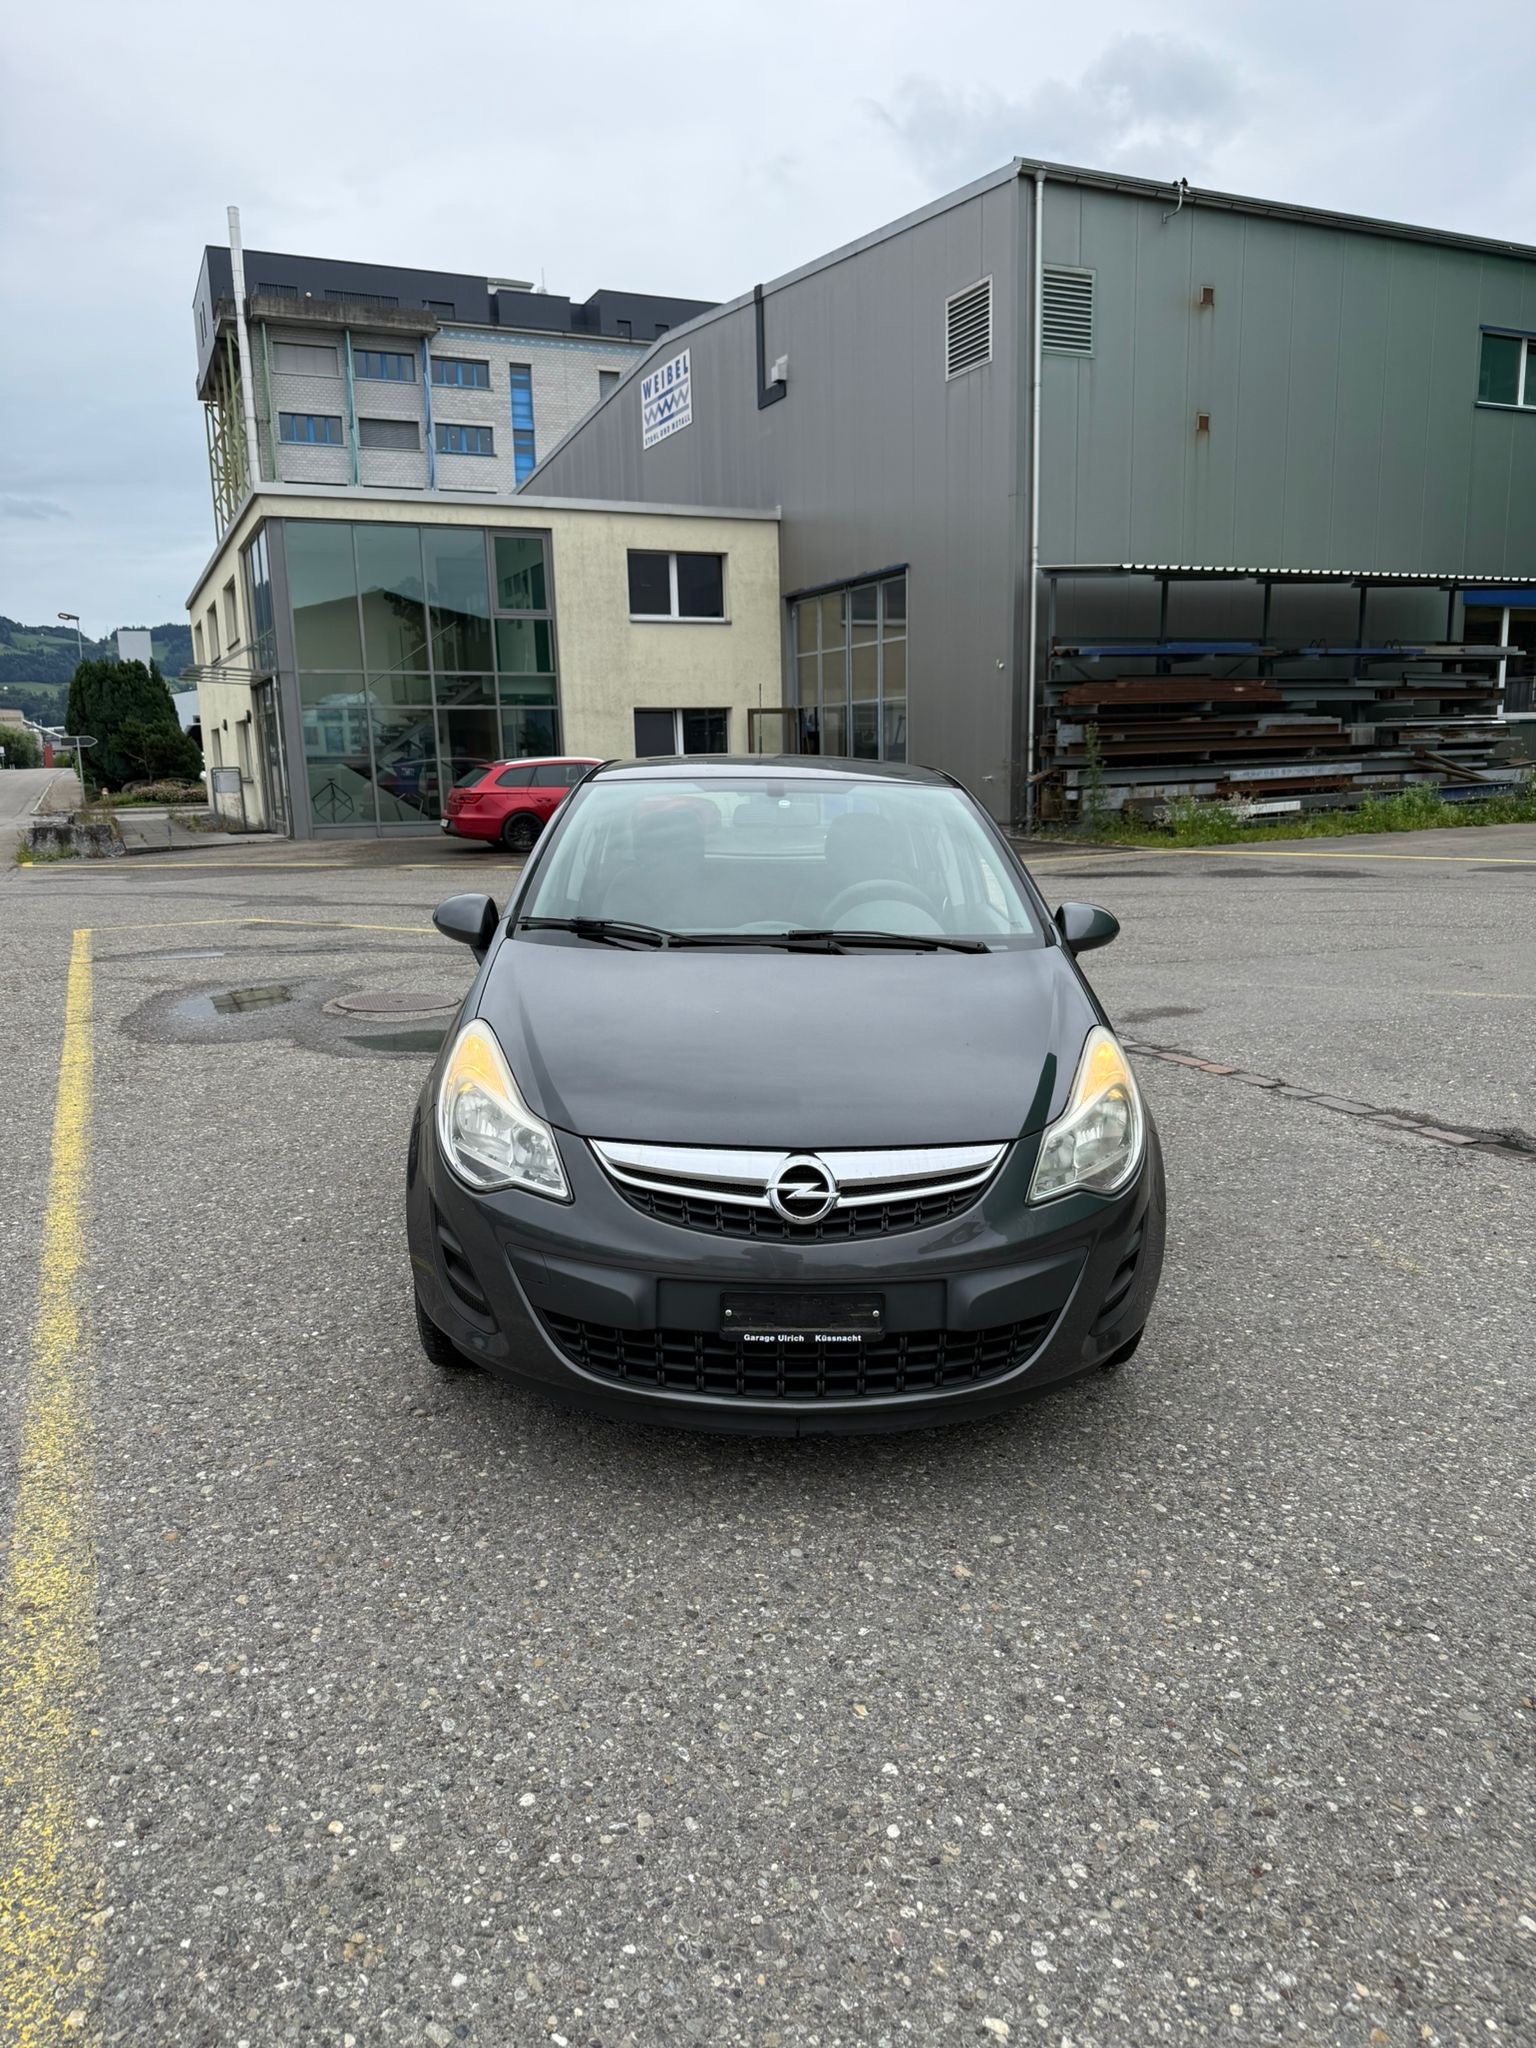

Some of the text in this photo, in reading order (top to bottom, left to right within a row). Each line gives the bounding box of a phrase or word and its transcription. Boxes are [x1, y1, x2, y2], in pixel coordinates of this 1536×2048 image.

[643, 355, 688, 400] WEIBEL
[645, 431, 660, 446] STAHL
[660, 425, 670, 437] UND
[743, 1333, 862, 1342] Garage Ulrich Küssnacht
